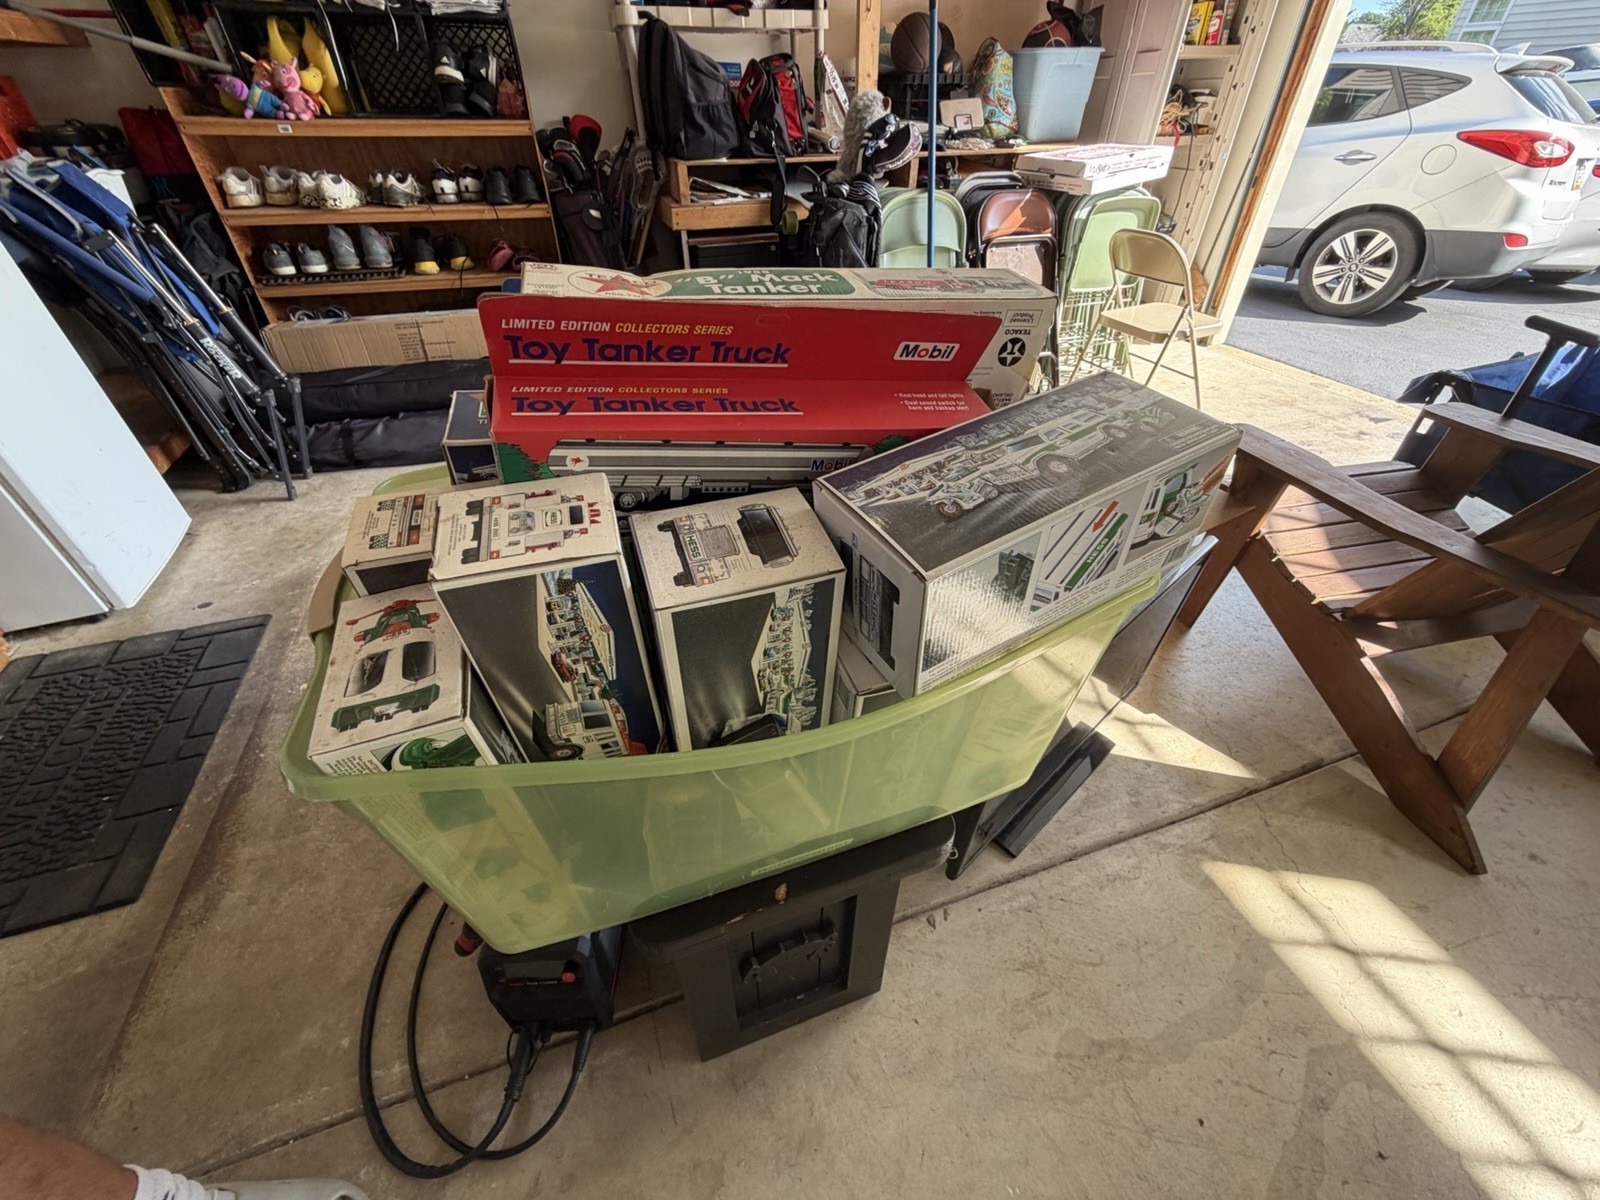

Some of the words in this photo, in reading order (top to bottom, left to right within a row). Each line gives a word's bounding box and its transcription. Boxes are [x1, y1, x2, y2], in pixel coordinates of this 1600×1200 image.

[750, 272, 840, 283] Mack
[704, 281, 823, 295] Tanker
[501, 318, 556, 331] LIMITED
[560, 320, 611, 333] EDITION
[615, 322, 690, 335] COLLECTORS
[693, 324, 734, 336] SERIES
[503, 335, 571, 364] Toy
[582, 337, 701, 364] Tanker
[709, 341, 791, 364] Truck
[899, 343, 956, 360] Mobil
[511, 386, 562, 394] LIMITED
[566, 386, 614, 394] EDITION
[618, 387, 689, 395] COLLECTORS
[692, 387, 729, 395] SERIES
[511, 396, 577, 416] Toy
[587, 397, 706, 413] Tanker
[712, 398, 801, 413] Truck
[811, 459, 852, 472] Mobil
[550, 510, 558, 526] HESS
[686, 534, 701, 558] HESS
[1086, 538, 1109, 563] HESS
